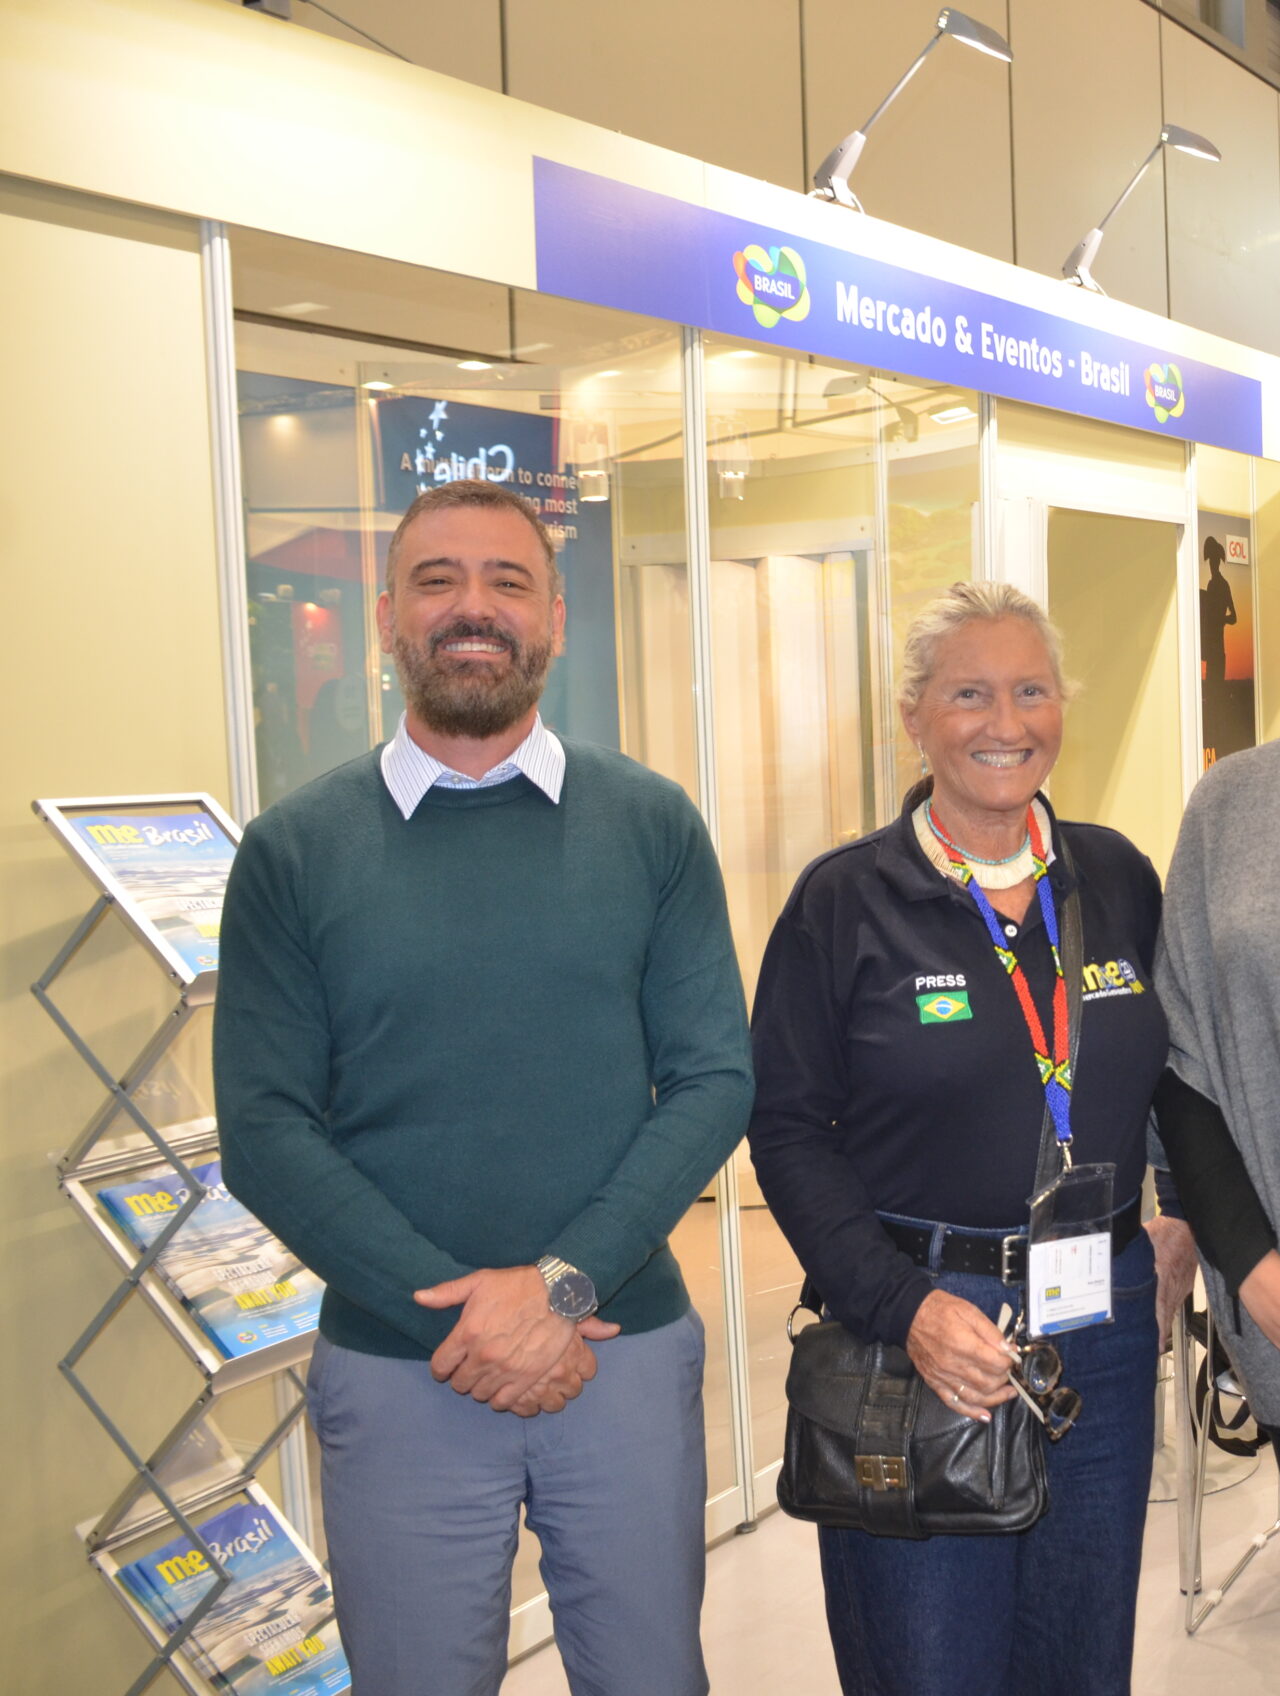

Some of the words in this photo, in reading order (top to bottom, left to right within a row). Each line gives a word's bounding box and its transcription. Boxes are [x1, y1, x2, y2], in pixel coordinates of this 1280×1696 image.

[753, 273, 795, 301] BRASIL
[836, 281, 947, 348] Mercado
[954, 315, 973, 354] &
[981, 323, 1063, 379] Eventos
[1081, 350, 1130, 397] Brasil
[1153, 382, 1177, 403] BRASIL
[400, 452, 413, 471] A
[517, 467, 533, 485] to
[537, 472, 578, 490] conne
[545, 498, 578, 515] most
[1228, 540, 1246, 560] GOL
[142, 820, 214, 846] Brasil
[915, 974, 966, 990] PRESS
[296, 1634, 326, 1657] YOU
